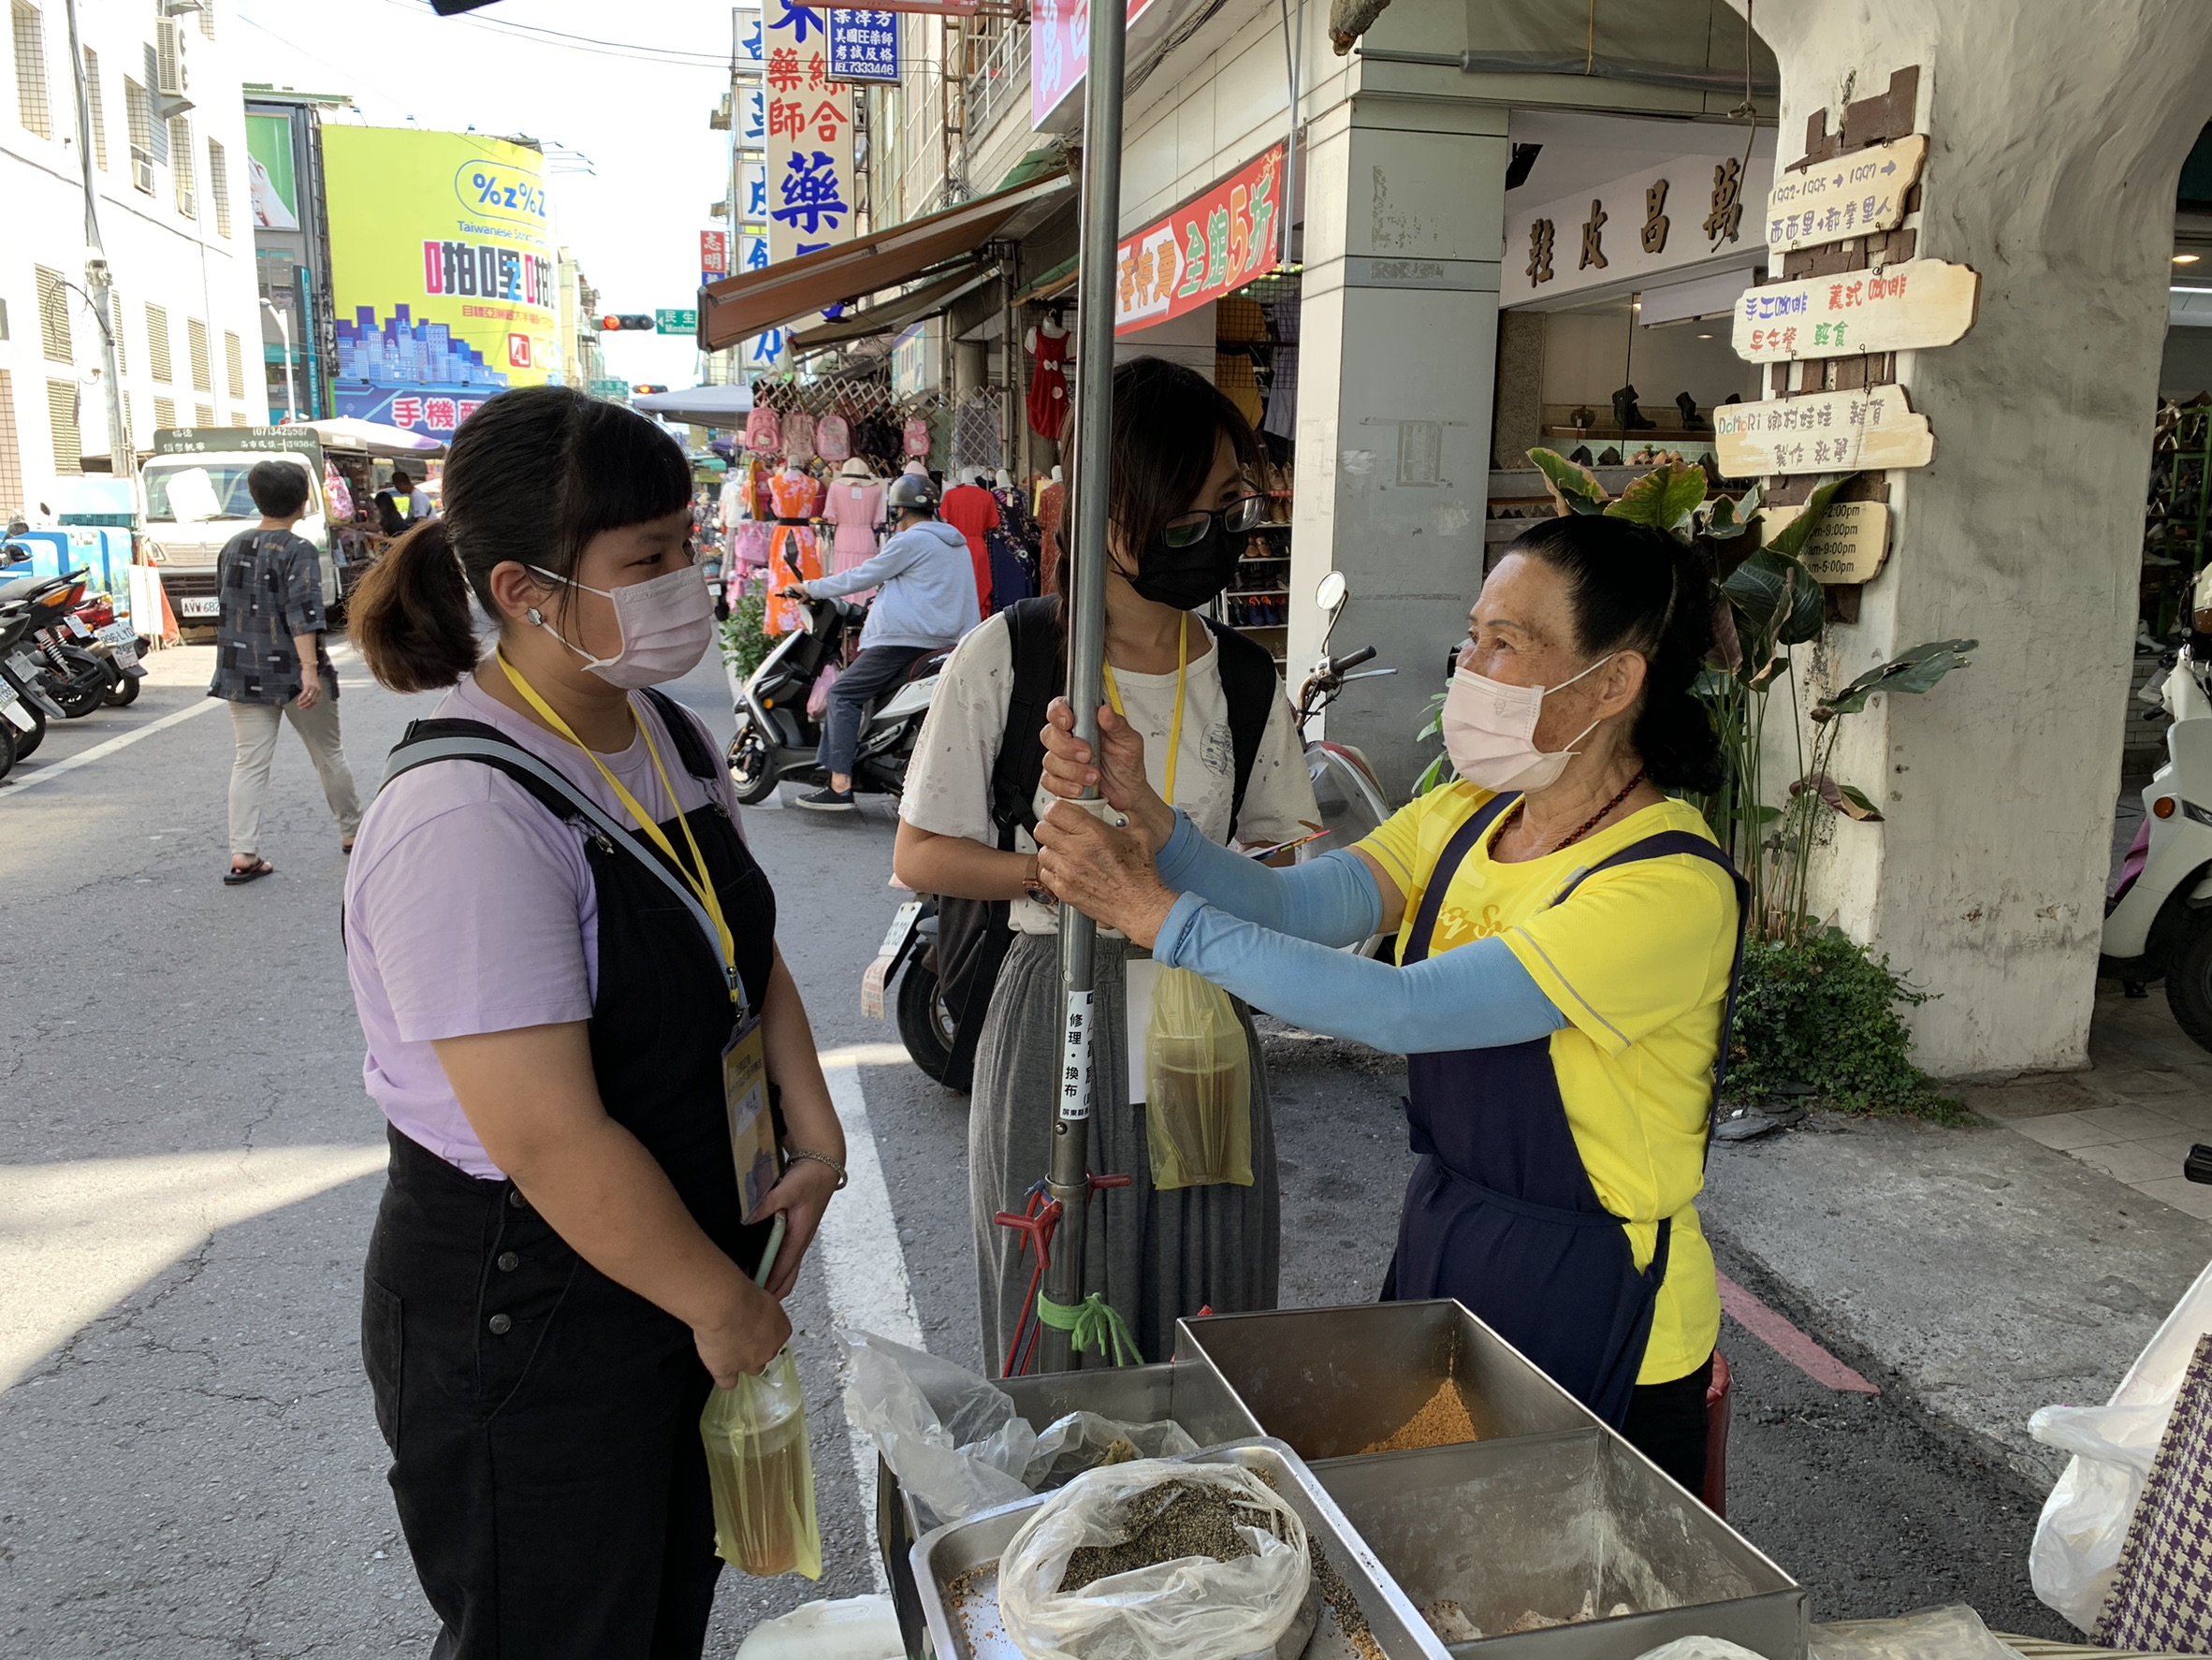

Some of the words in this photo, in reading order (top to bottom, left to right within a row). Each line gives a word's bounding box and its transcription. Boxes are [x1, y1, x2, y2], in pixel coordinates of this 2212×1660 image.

[835, 44, 895, 62] 考試及格
[457, 220, 514, 239] Taiwanese
[703, 232, 722, 270] 志明
[665, 310, 695, 324] 民生
[1745, 291, 1809, 321] 手工咖啡
[1750, 326, 1797, 354] 早午餐
[1813, 320, 1849, 347] 輕食
